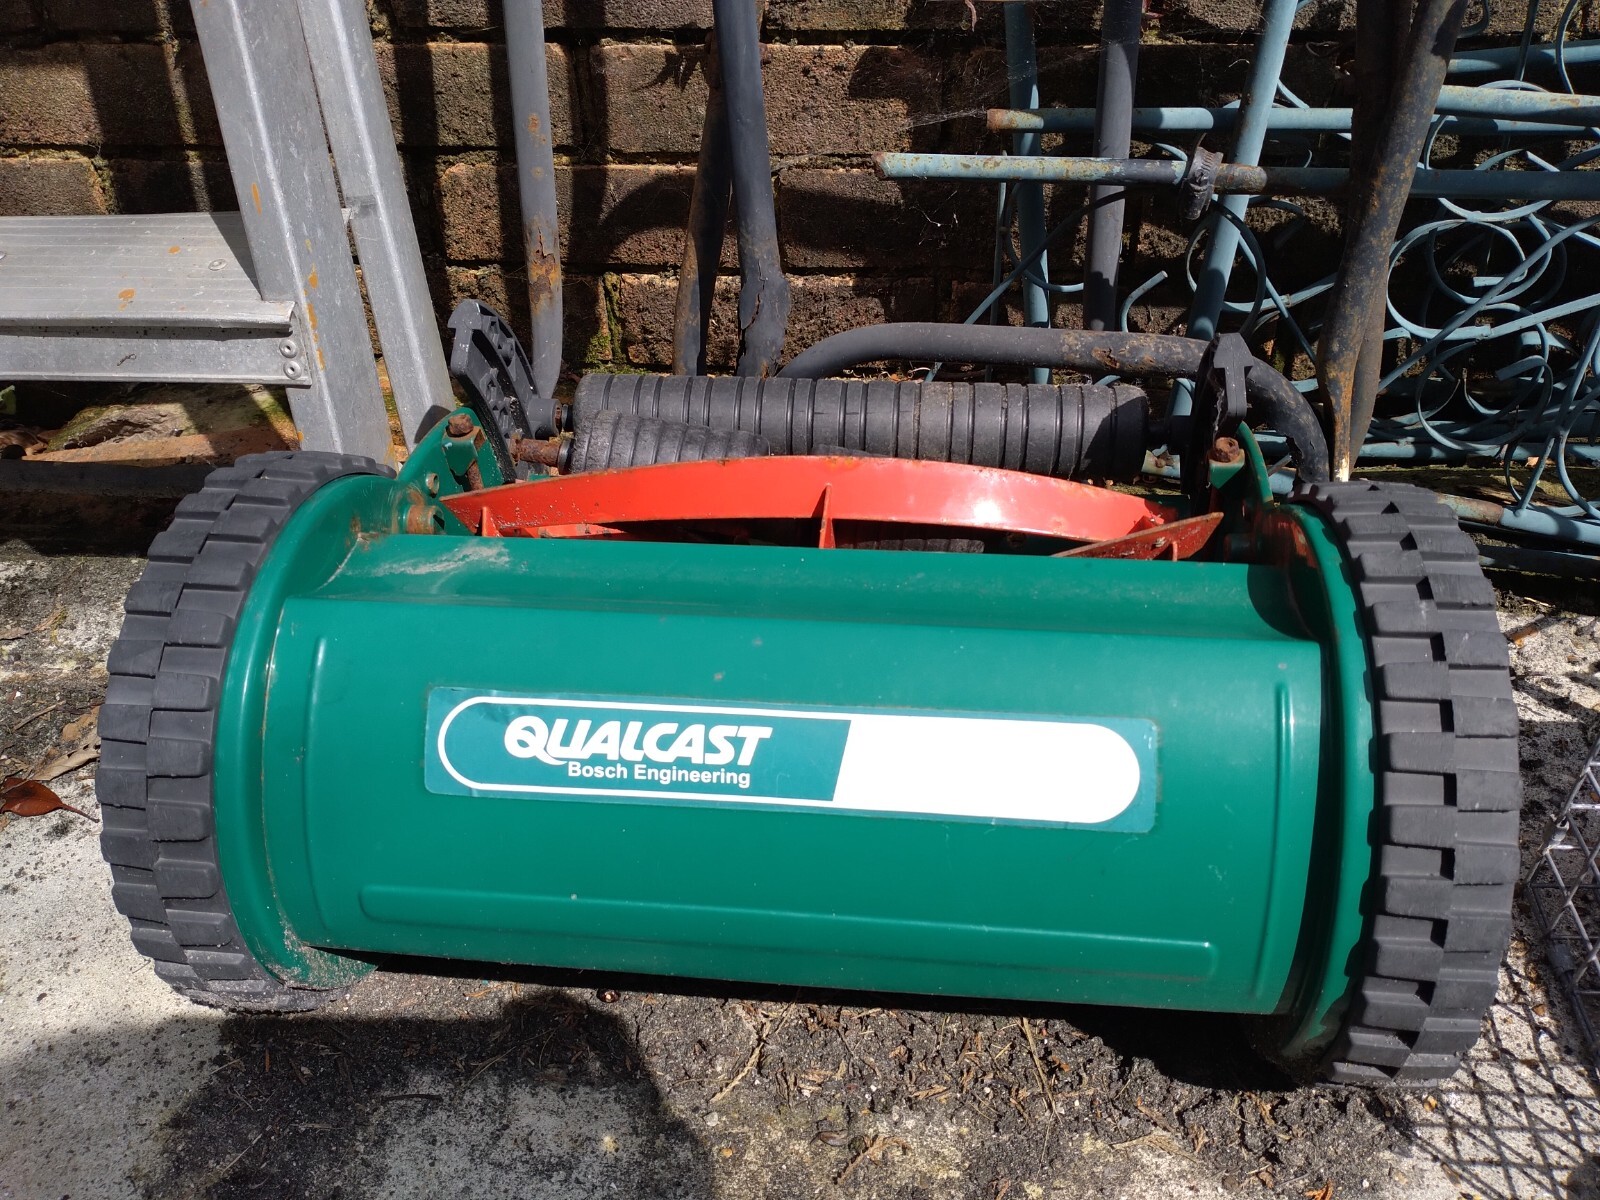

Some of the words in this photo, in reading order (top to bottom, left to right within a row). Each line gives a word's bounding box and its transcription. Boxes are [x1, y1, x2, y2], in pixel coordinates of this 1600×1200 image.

[504, 715, 773, 766] QUALCAST
[567, 761, 627, 779] Bosch
[634, 764, 750, 788] Engineering
